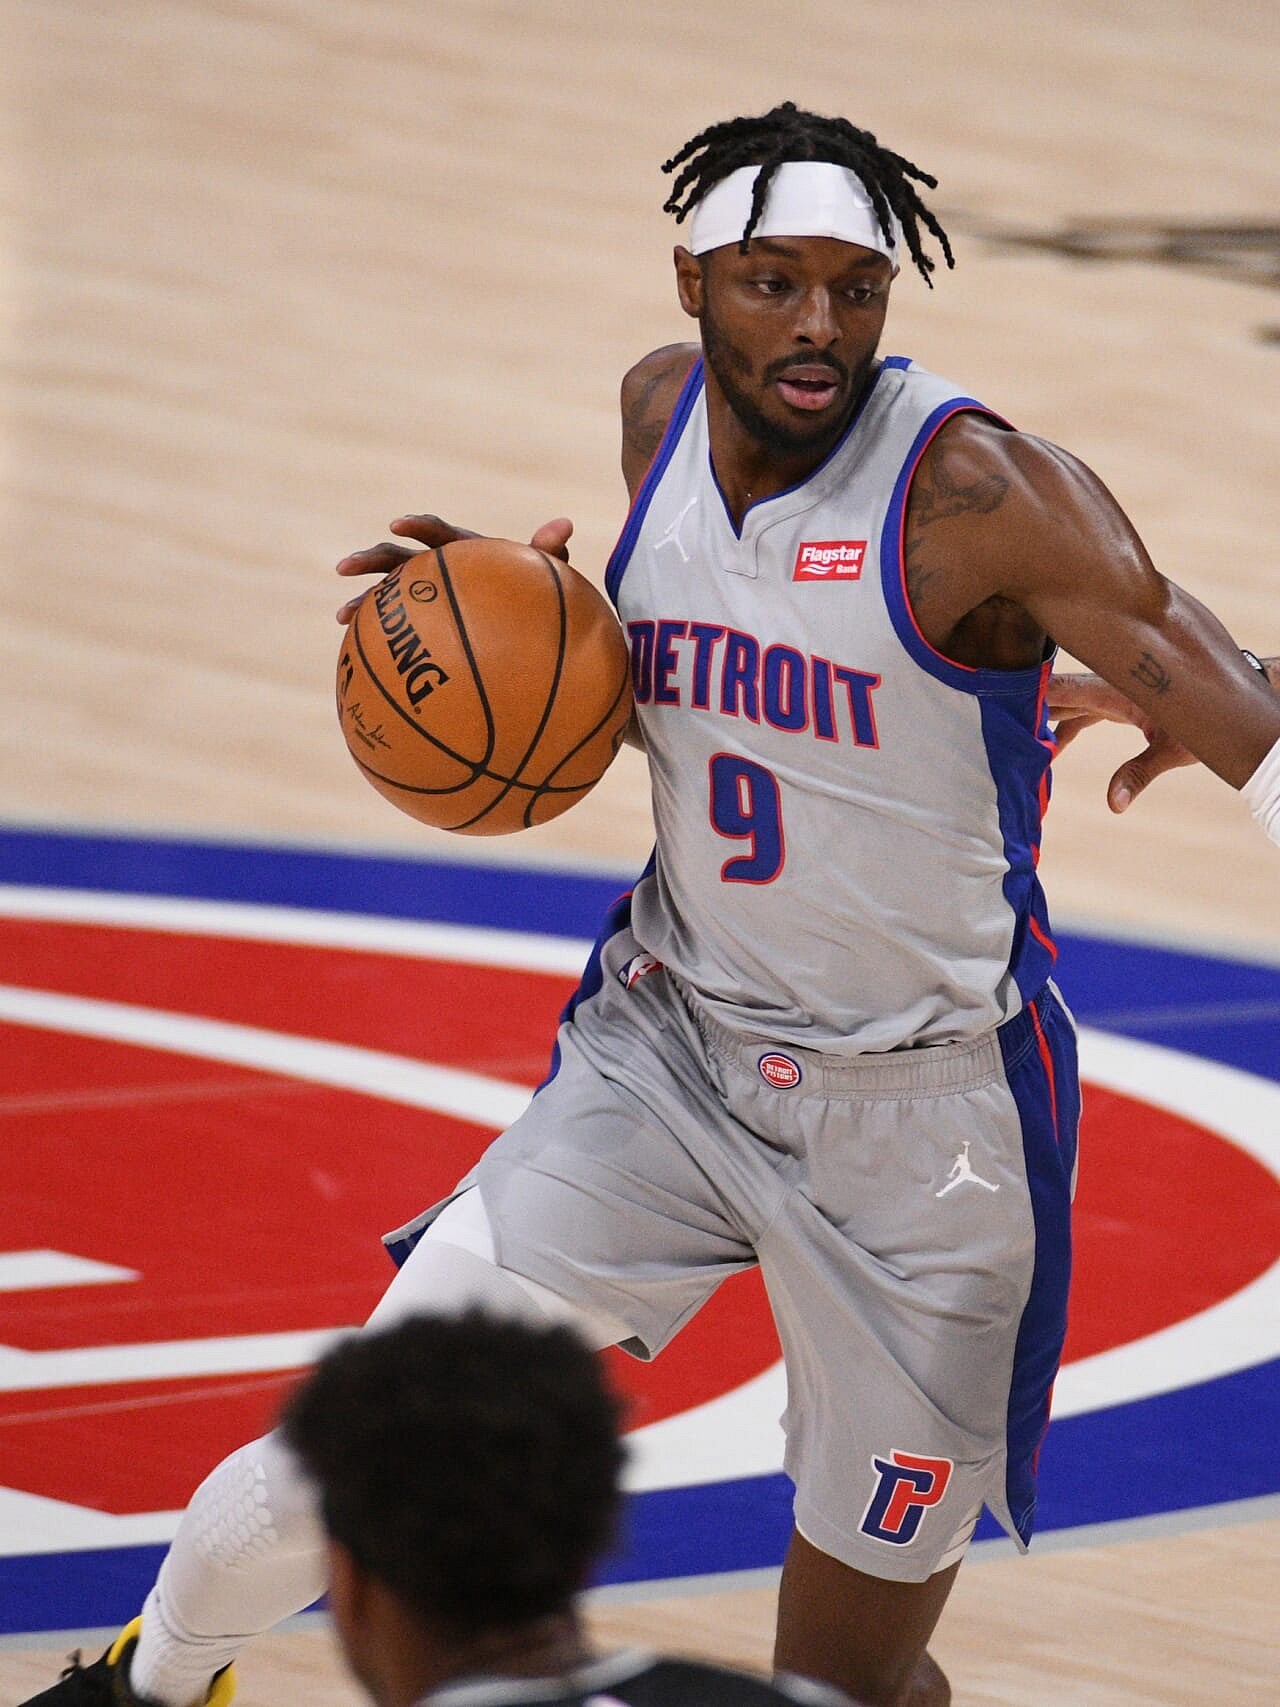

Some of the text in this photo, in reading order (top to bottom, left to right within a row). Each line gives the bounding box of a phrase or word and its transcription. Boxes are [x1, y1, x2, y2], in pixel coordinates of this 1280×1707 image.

[801, 545, 863, 565] Flagstar
[836, 564, 859, 573] Bank
[626, 618, 882, 750] DETROIT
[708, 751, 786, 886] 9
[766, 1062, 793, 1074] DETROIT
[766, 1069, 793, 1081] PISTONS
